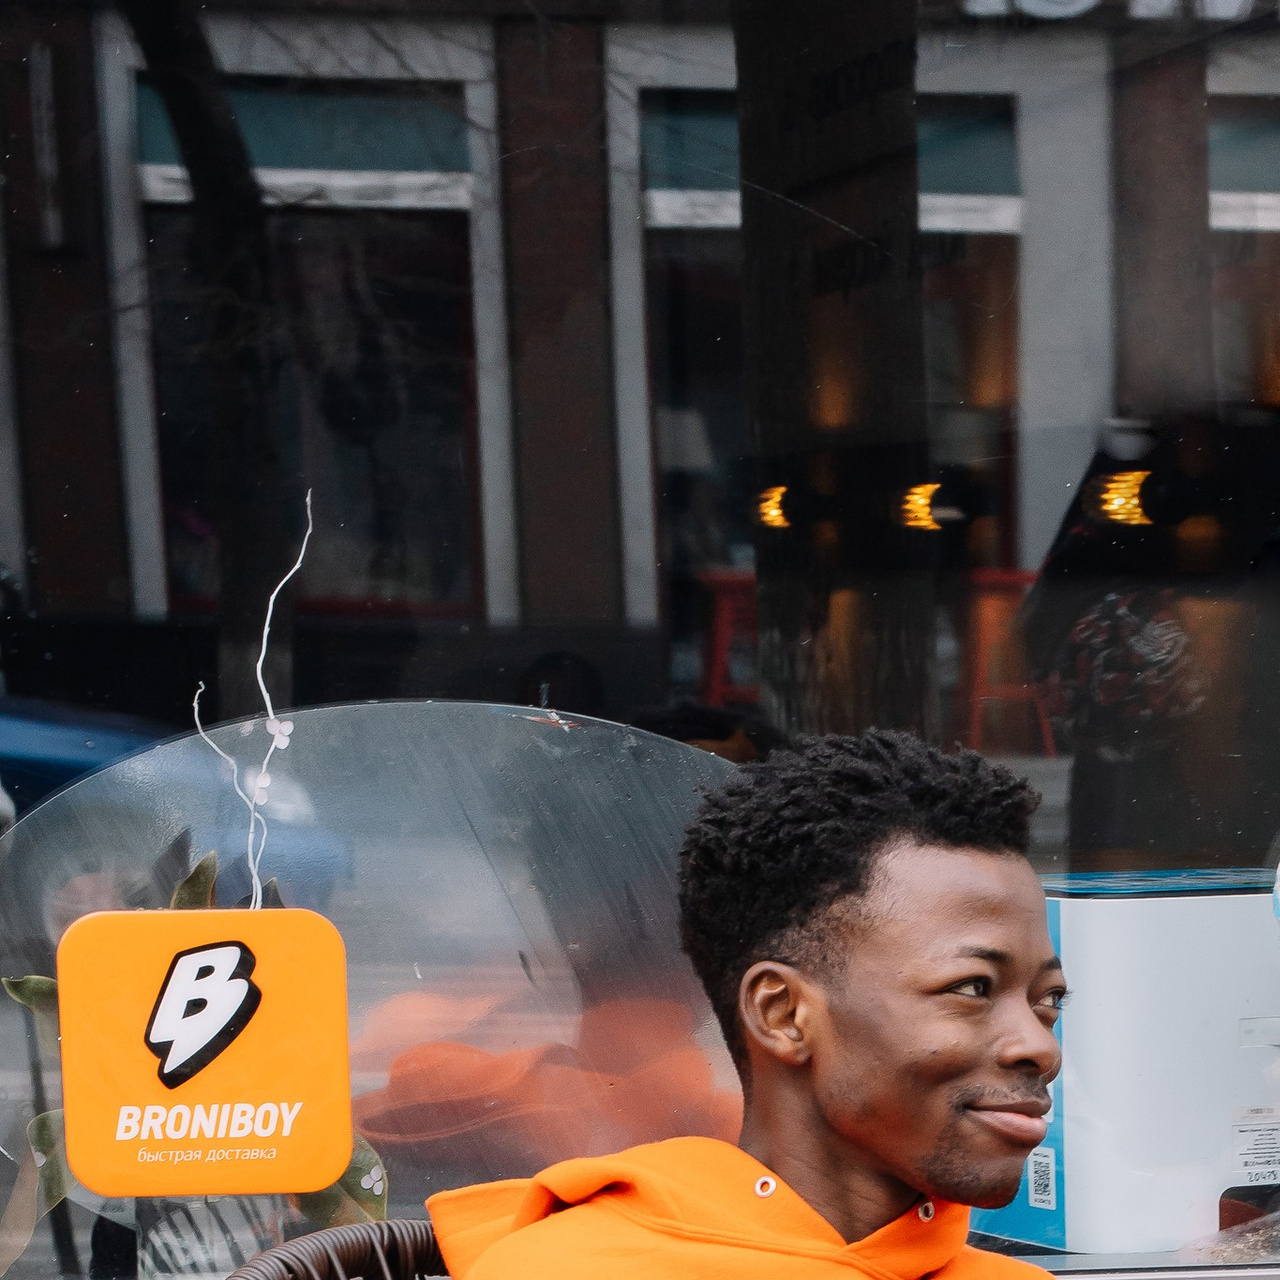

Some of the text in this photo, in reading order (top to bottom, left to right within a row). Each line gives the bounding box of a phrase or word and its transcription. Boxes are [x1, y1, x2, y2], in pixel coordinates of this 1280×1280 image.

[115, 1102, 303, 1141] BRONIBOY
[137, 1147, 277, 1165] быстрая доставка
